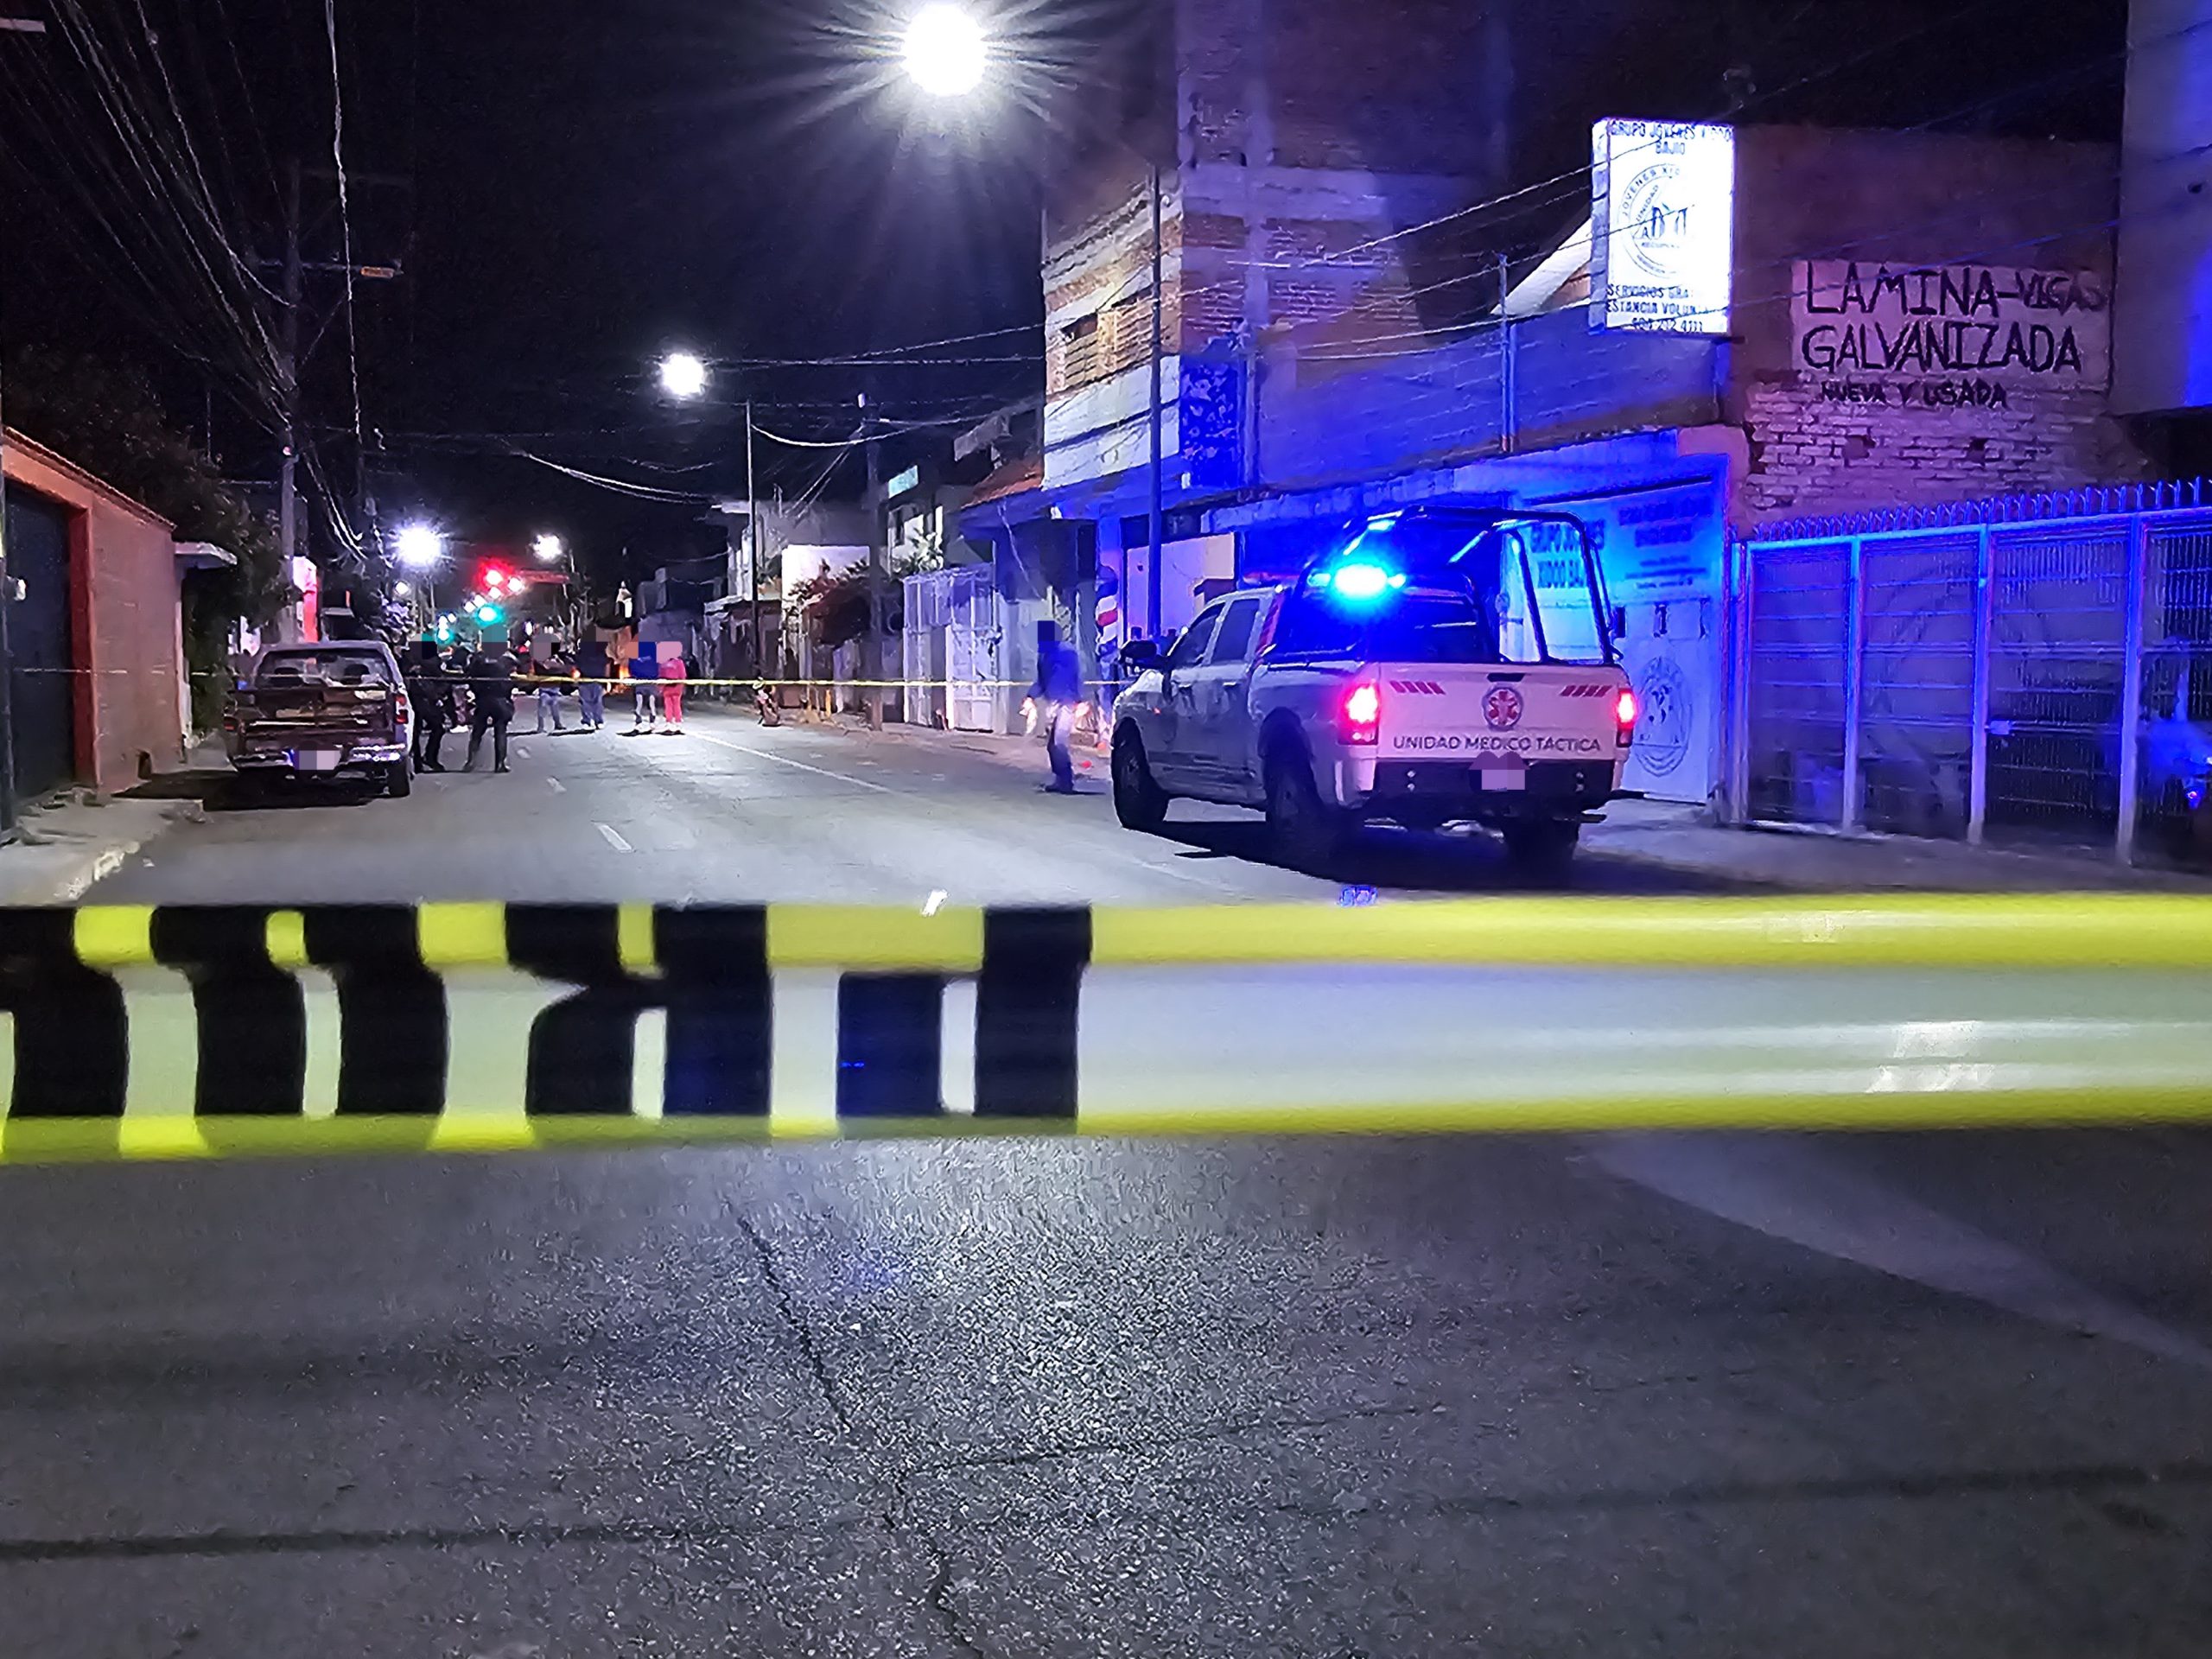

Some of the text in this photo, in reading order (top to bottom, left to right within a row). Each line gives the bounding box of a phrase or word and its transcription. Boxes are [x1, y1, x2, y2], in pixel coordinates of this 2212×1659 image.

[1636, 184, 1659, 221] UNIDAD
[1802, 321, 2081, 373] GALVANIZADA
[1822, 382, 1887, 404] NUEVA
[1923, 380, 2008, 408] USADA
[1394, 736, 1460, 750] UNIDAD
